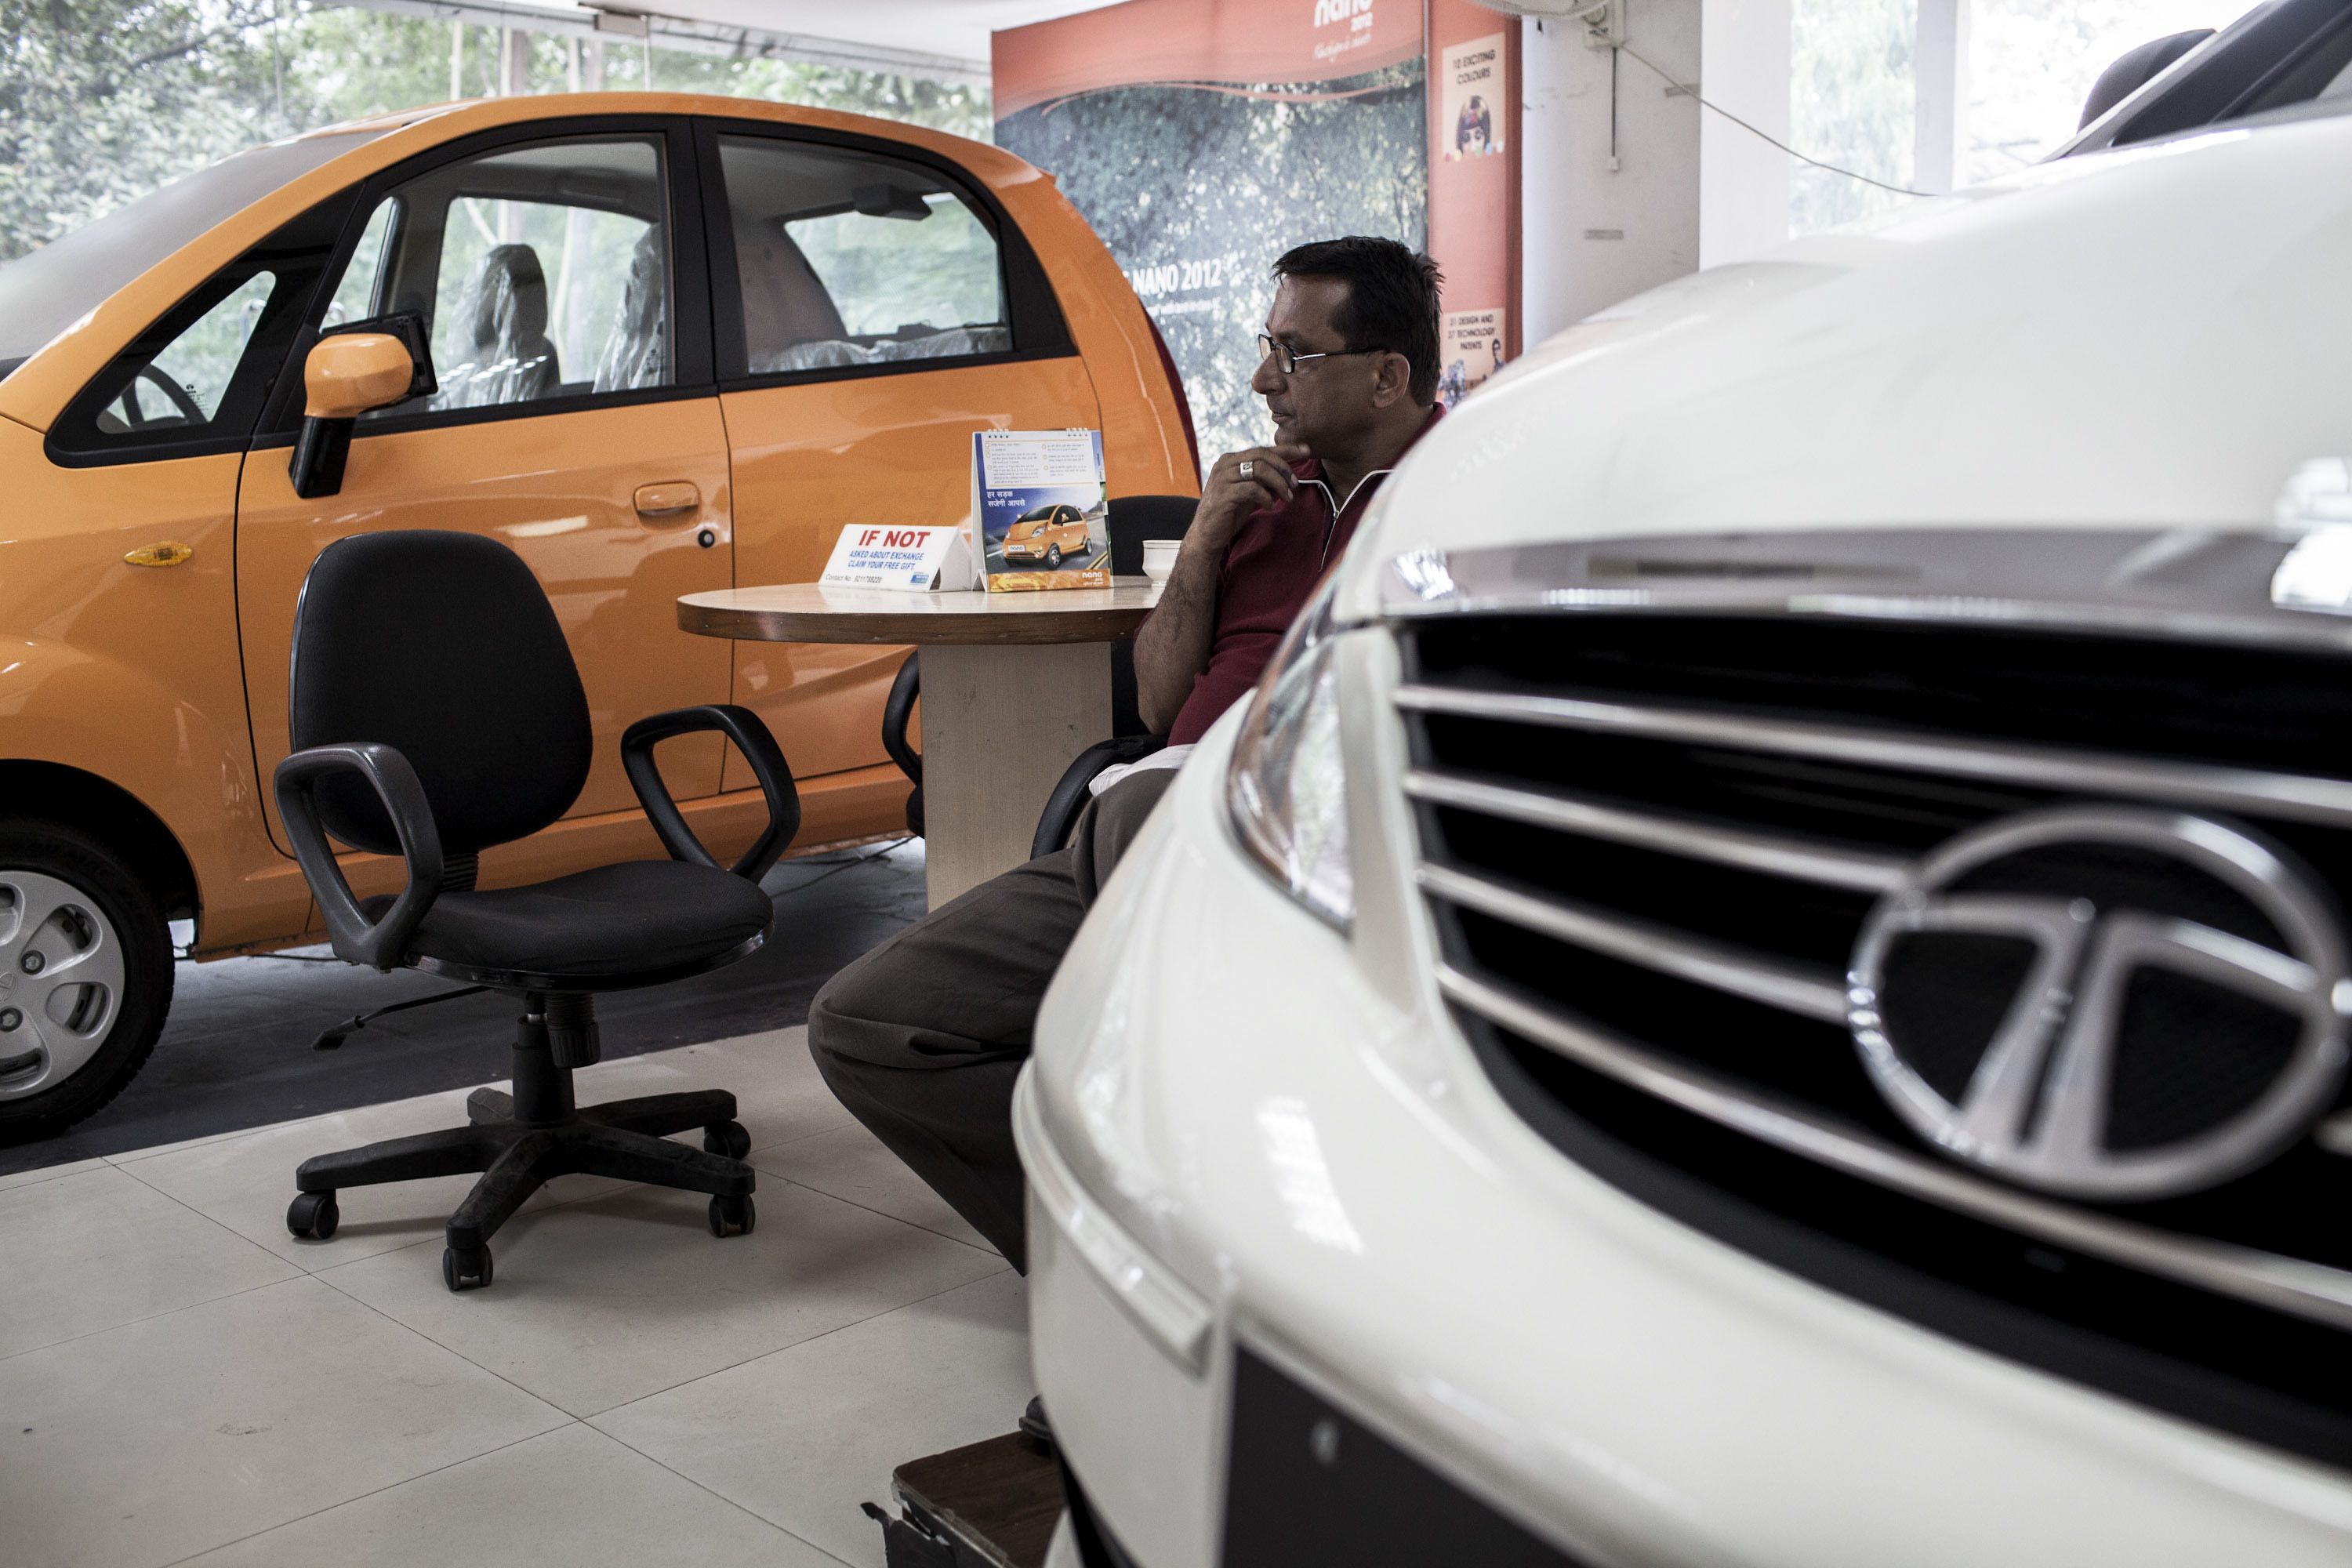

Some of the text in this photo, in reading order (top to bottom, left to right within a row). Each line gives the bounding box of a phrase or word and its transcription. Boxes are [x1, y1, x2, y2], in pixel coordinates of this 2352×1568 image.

[1462, 49, 1496, 67] EXCITING
[1456, 66, 1491, 85] COLOURS
[1132, 258, 1222, 296] NANO 2012
[1481, 314, 1494, 323] AND
[858, 530, 931, 548] IF NOT
[869, 551, 891, 560] ABOUT
[890, 552, 924, 561] EXCHANGE
[867, 561, 885, 569] YOUR
[884, 561, 900, 570] FREE
